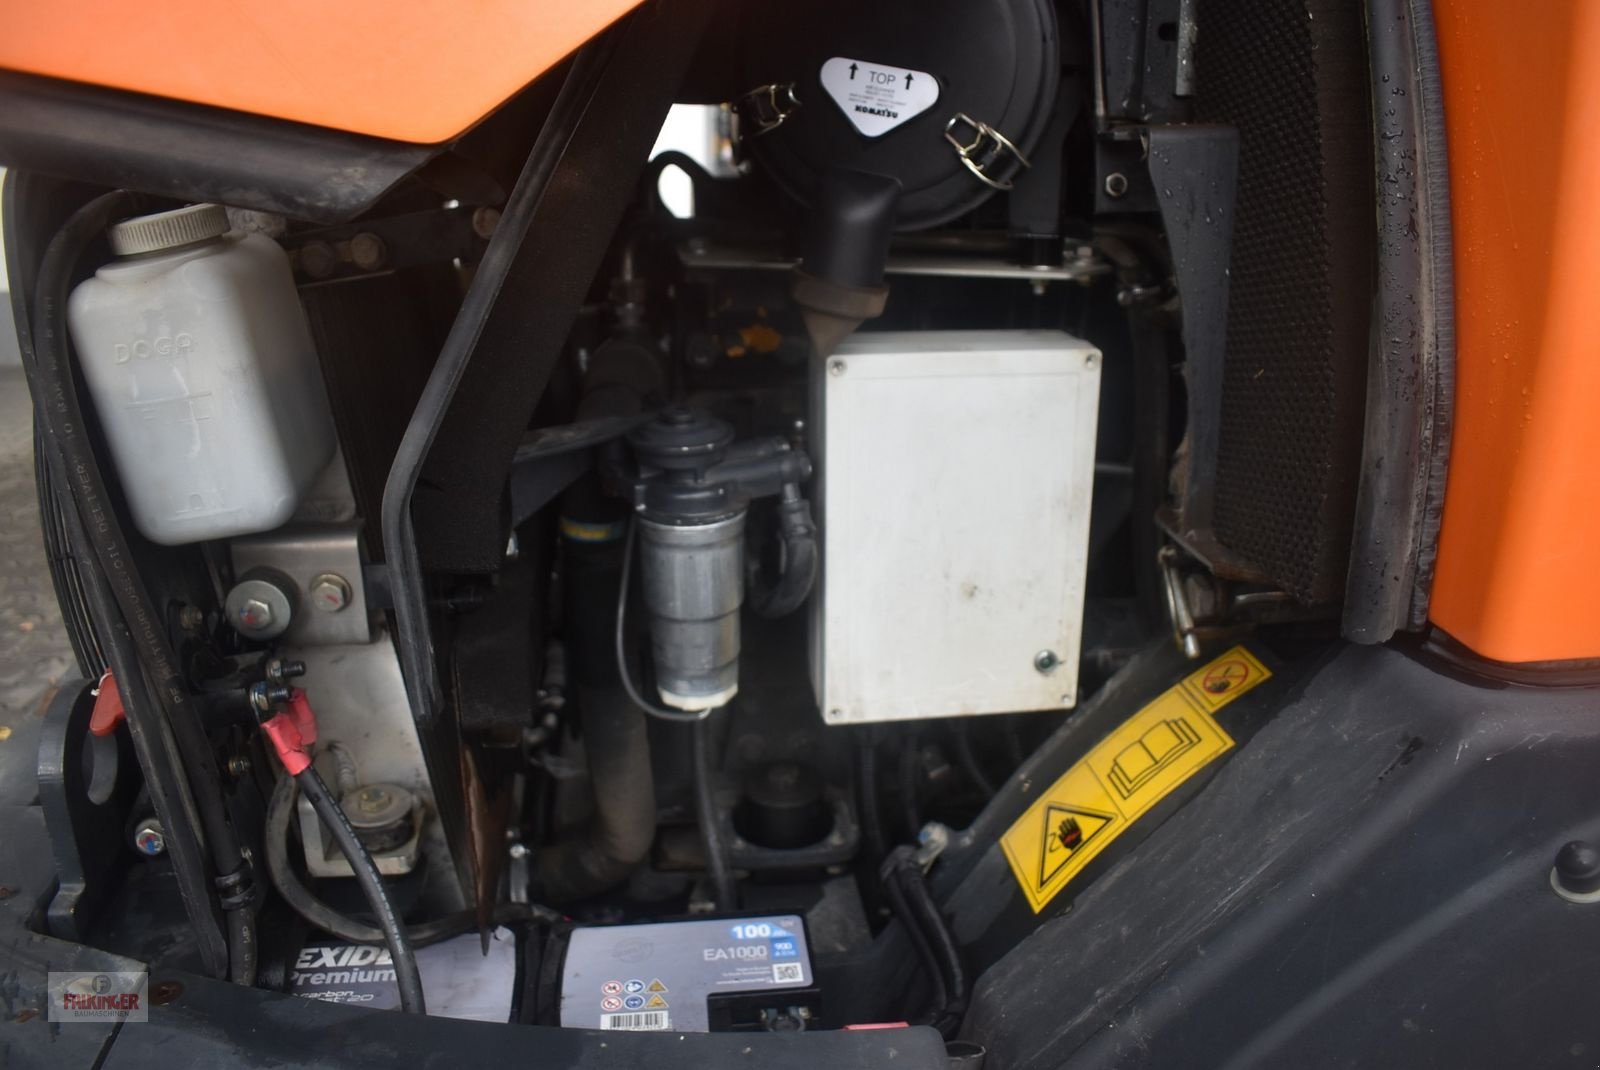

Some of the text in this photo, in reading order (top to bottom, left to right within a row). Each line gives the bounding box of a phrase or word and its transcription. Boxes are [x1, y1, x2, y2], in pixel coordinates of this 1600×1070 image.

[869, 70, 896, 85] TOP
[855, 105, 898, 119] KOMATSU
[732, 924, 771, 939] 100
[703, 945, 768, 961] EA1000
